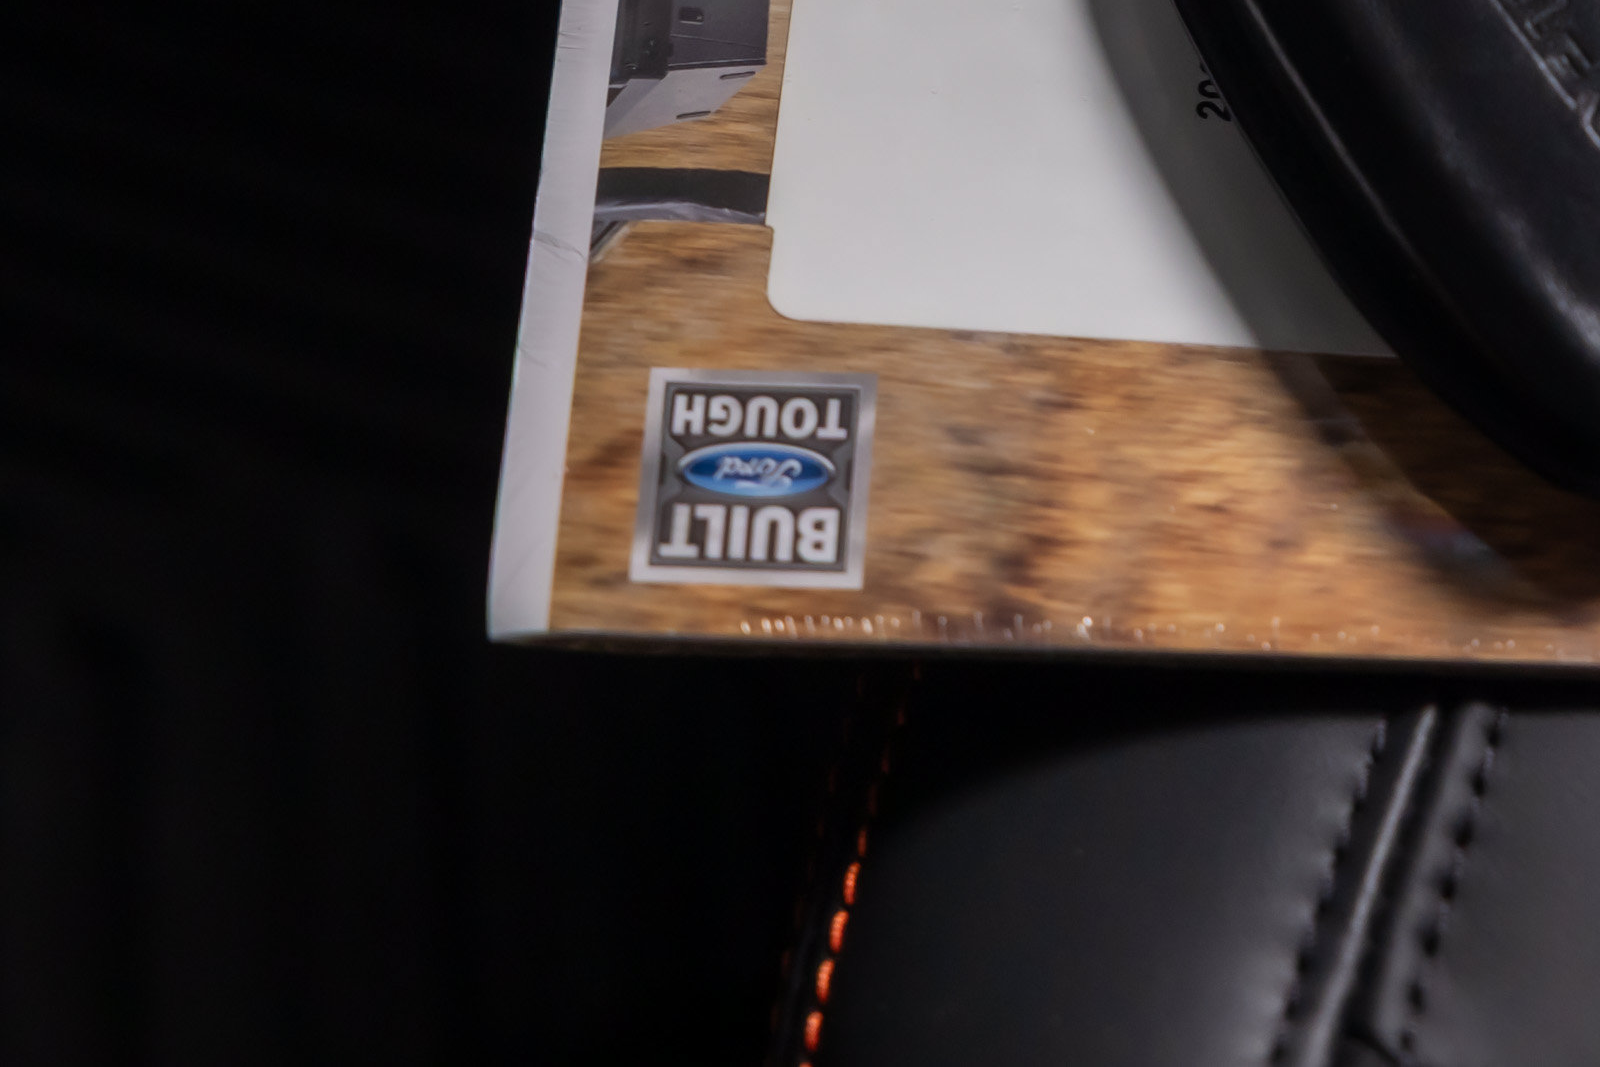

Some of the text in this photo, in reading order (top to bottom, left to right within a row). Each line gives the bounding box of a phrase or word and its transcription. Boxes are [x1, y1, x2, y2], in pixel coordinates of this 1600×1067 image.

[671, 392, 849, 441] TOUGH
[712, 455, 803, 490] Ford
[657, 502, 841, 565] BUILT
